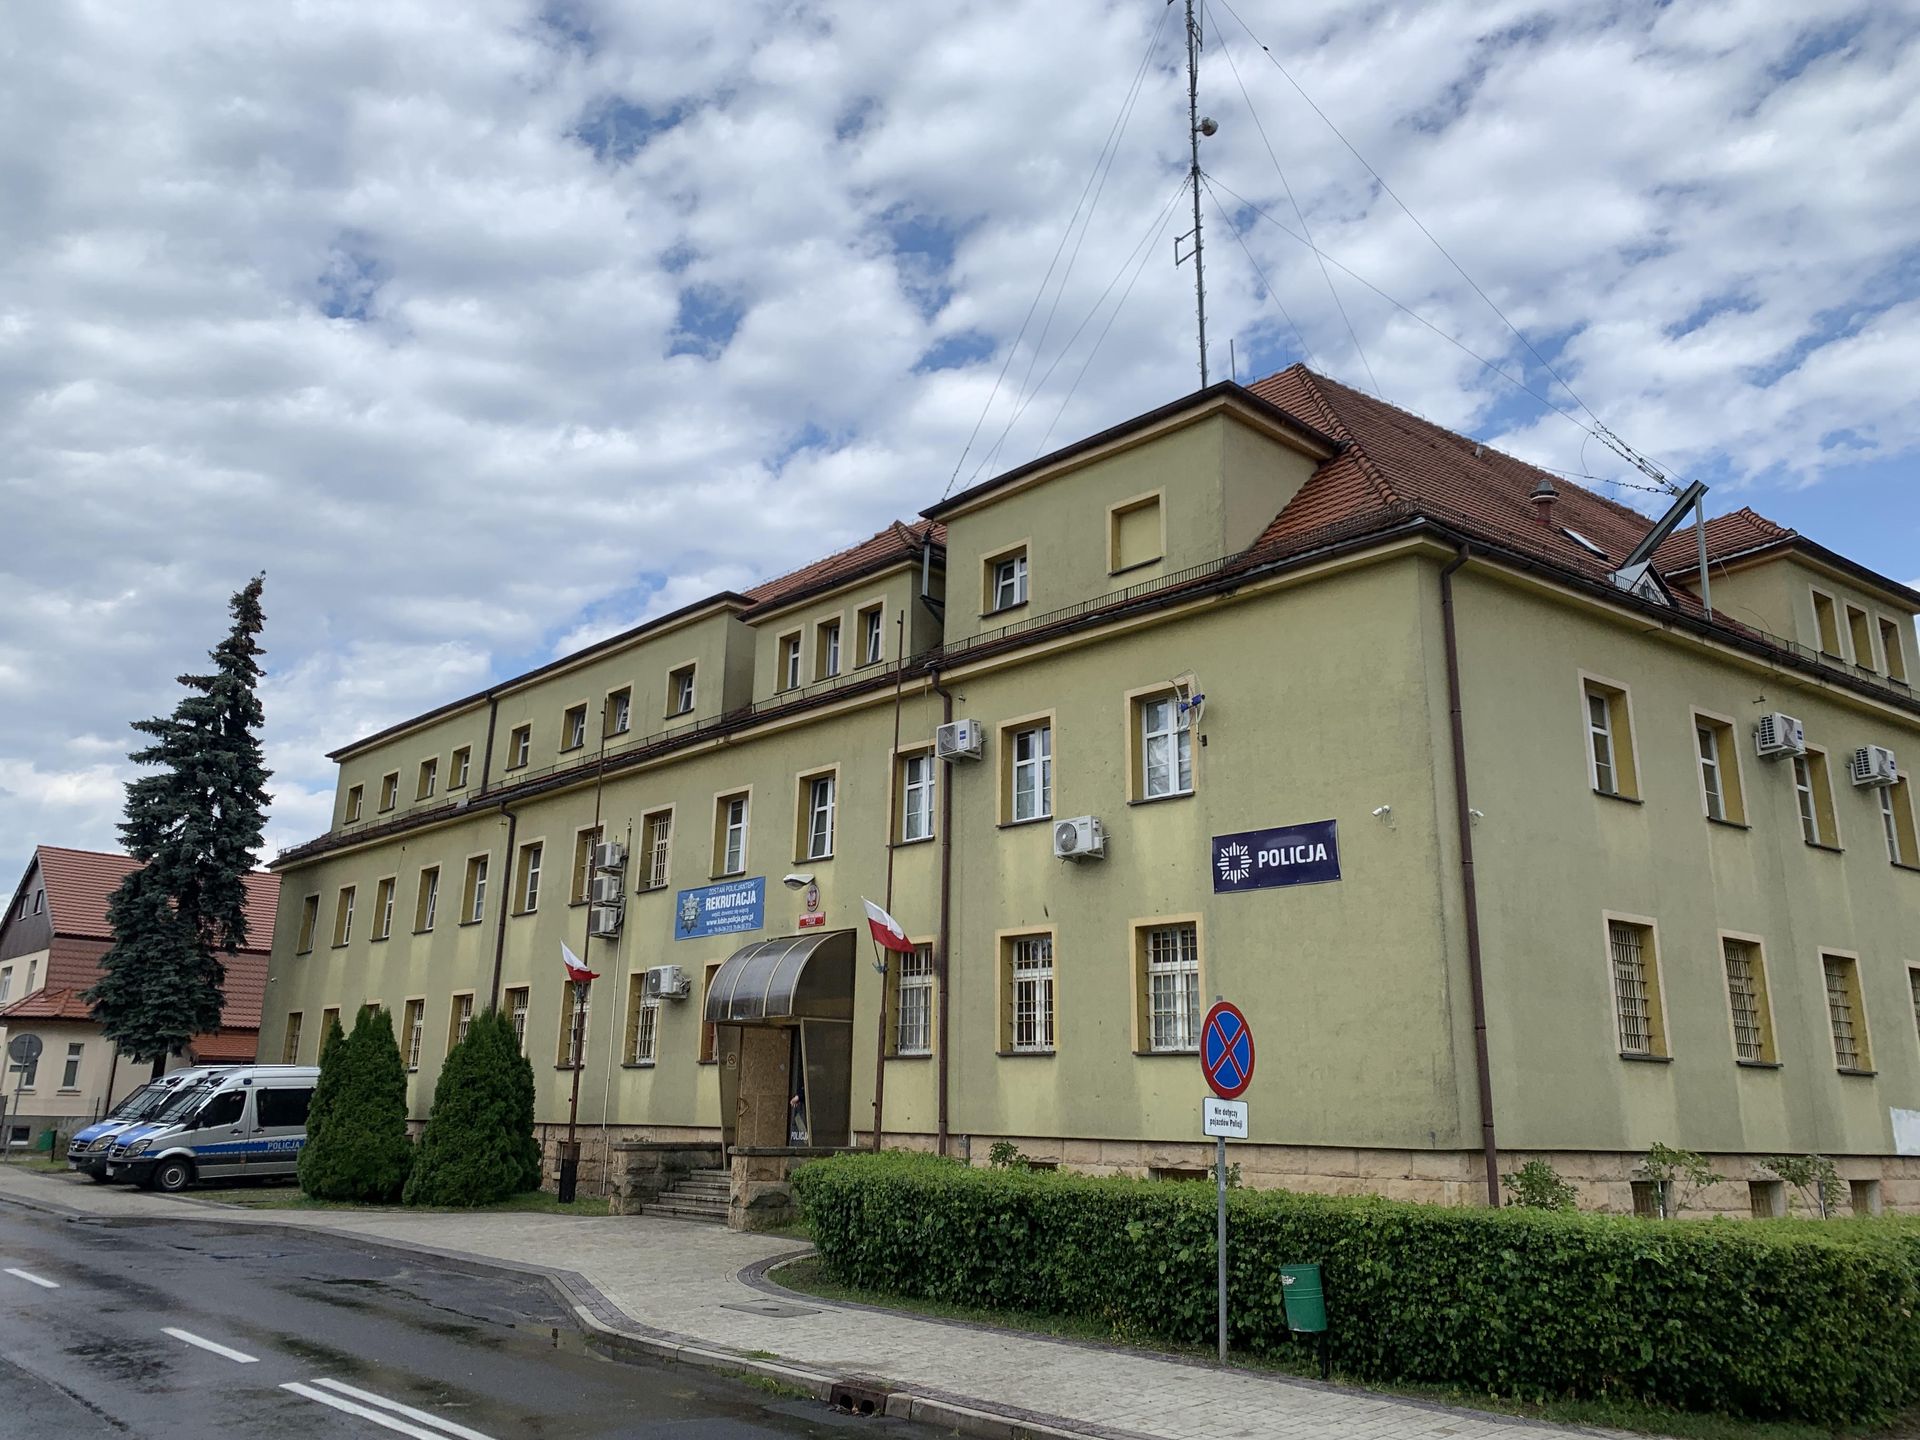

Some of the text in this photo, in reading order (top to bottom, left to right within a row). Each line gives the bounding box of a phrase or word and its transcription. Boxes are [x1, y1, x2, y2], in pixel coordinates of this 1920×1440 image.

[1258, 842, 1328, 869] POLICJA
[705, 891, 756, 911] REKRUTACJA
[1214, 1107, 1238, 1119] Nie dotyczy
[267, 1141, 300, 1150] POLICJA
